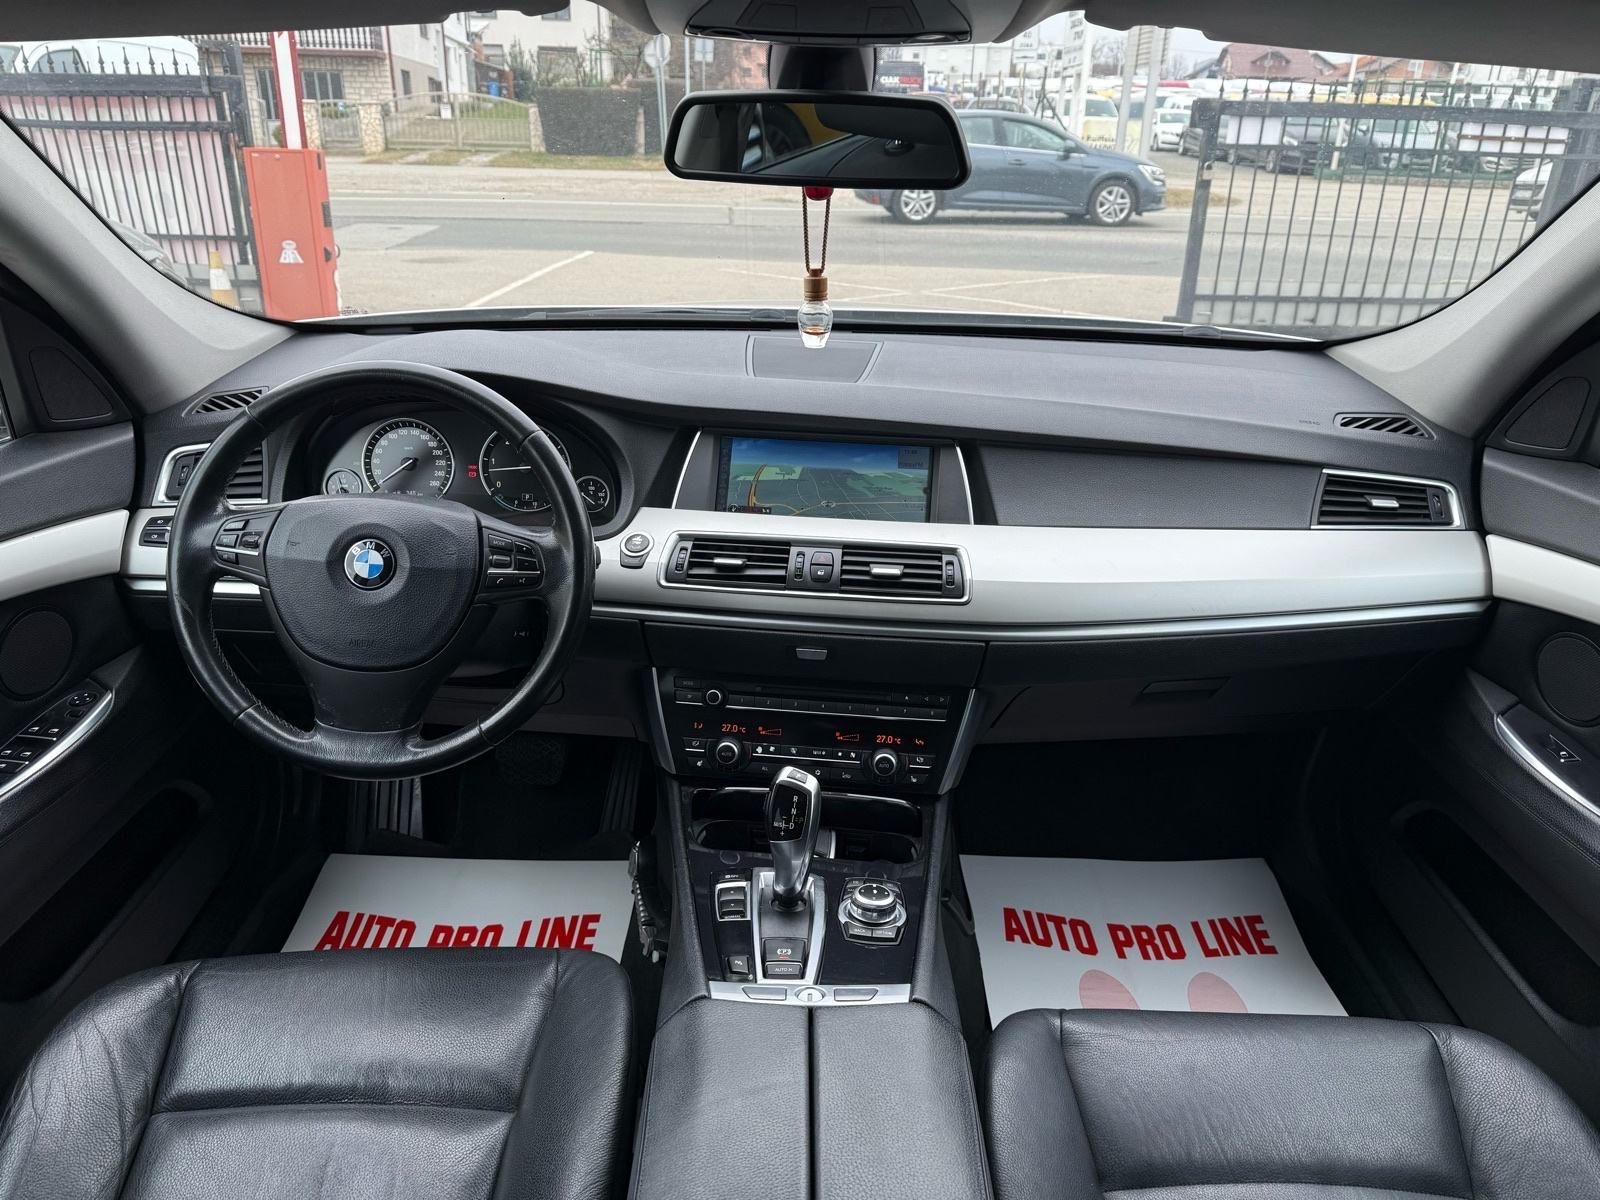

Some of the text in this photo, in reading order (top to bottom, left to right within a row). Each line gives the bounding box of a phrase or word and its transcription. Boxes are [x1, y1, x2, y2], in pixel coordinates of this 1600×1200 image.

[721, 723, 738, 733] 27.0
[876, 734, 893, 744] 27.0
[793, 795, 799, 803] R
[791, 807, 797, 815] N
[789, 822, 795, 830] D
[313, 910, 602, 952] AUTO PRO LINE
[1002, 906, 1279, 961] AUTO PRO LINE
